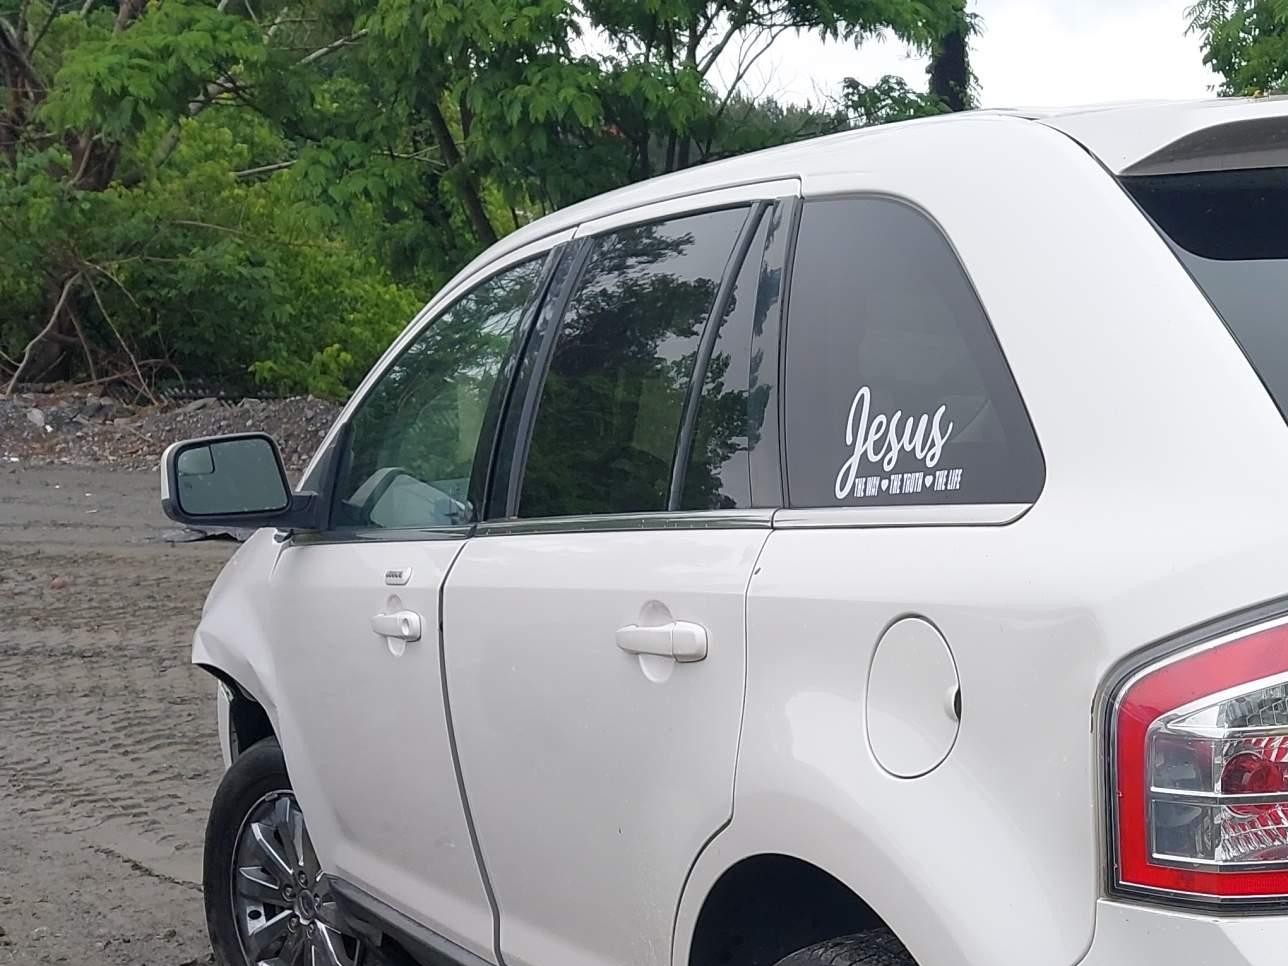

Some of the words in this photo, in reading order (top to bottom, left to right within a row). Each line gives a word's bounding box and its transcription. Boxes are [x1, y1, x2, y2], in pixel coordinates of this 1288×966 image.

[835, 386, 953, 499] Jesus
[854, 477, 866, 497] THE
[889, 474, 902, 494] THE
[902, 472, 924, 493] TRUTH
[934, 470, 948, 491] THE
[947, 469, 962, 490] LIFE
